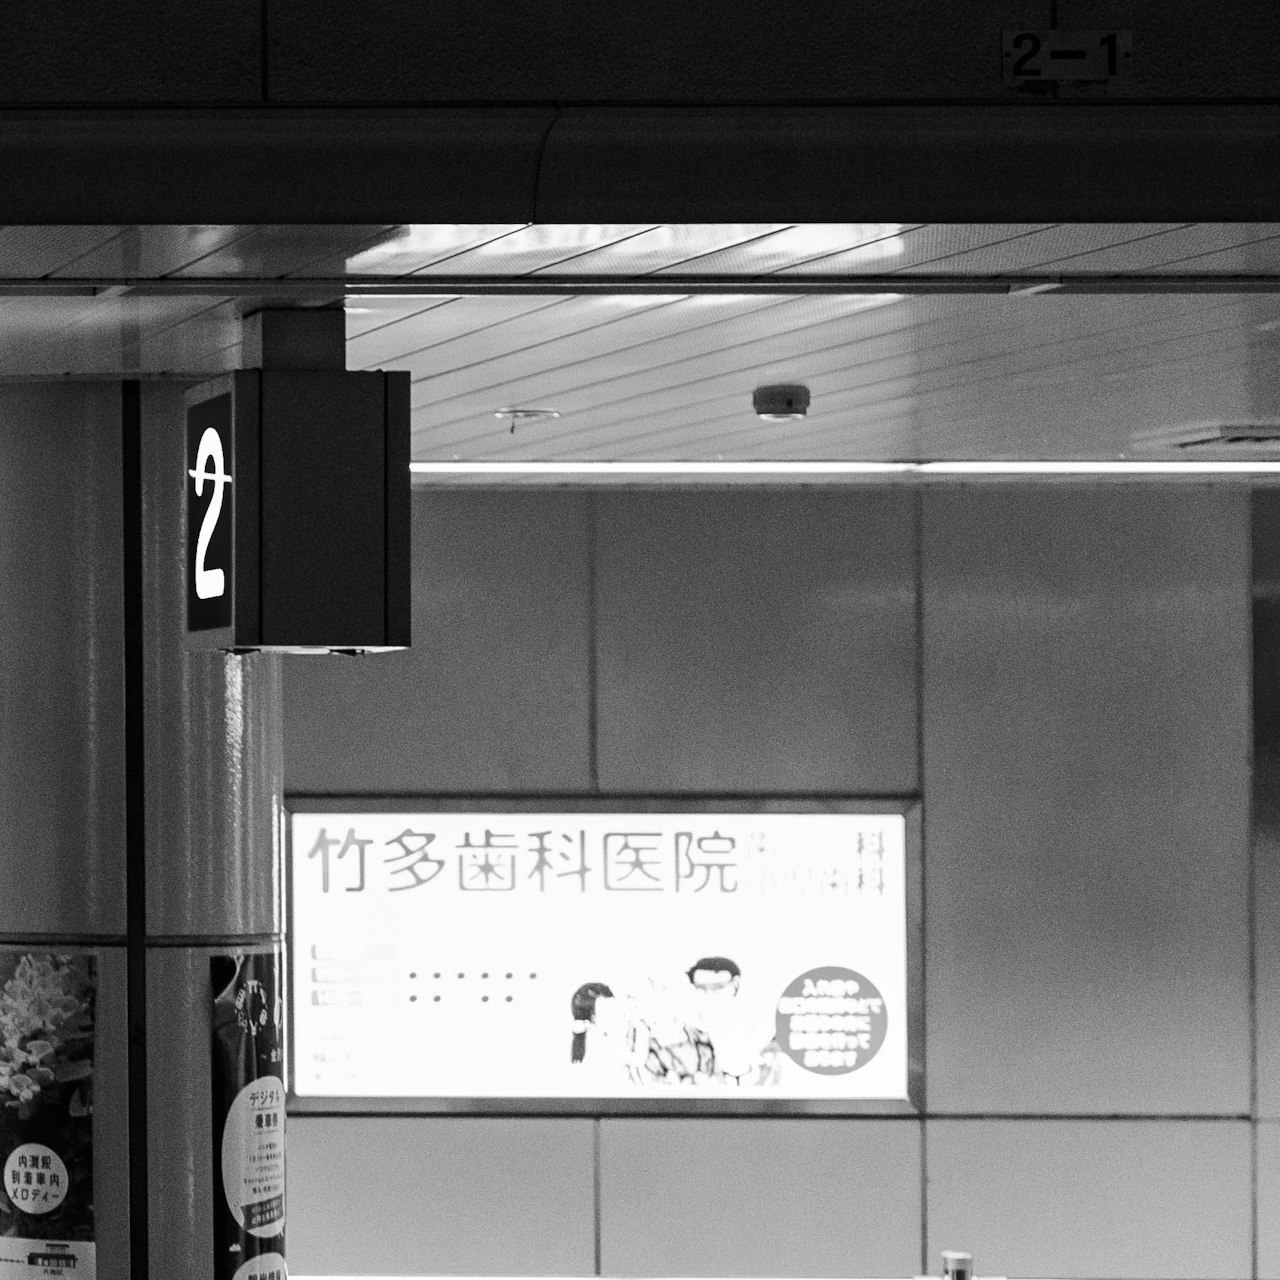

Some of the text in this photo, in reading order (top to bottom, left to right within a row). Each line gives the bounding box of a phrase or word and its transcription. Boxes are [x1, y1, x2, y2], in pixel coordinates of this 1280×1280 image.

[1012, 32, 1117, 77] 2-1
[190, 427, 231, 599] 2
[306, 827, 738, 893] 竹多歯科医院
[11, 1170, 60, 1187] 到着車内
[11, 1188, 60, 1202] メロディー
